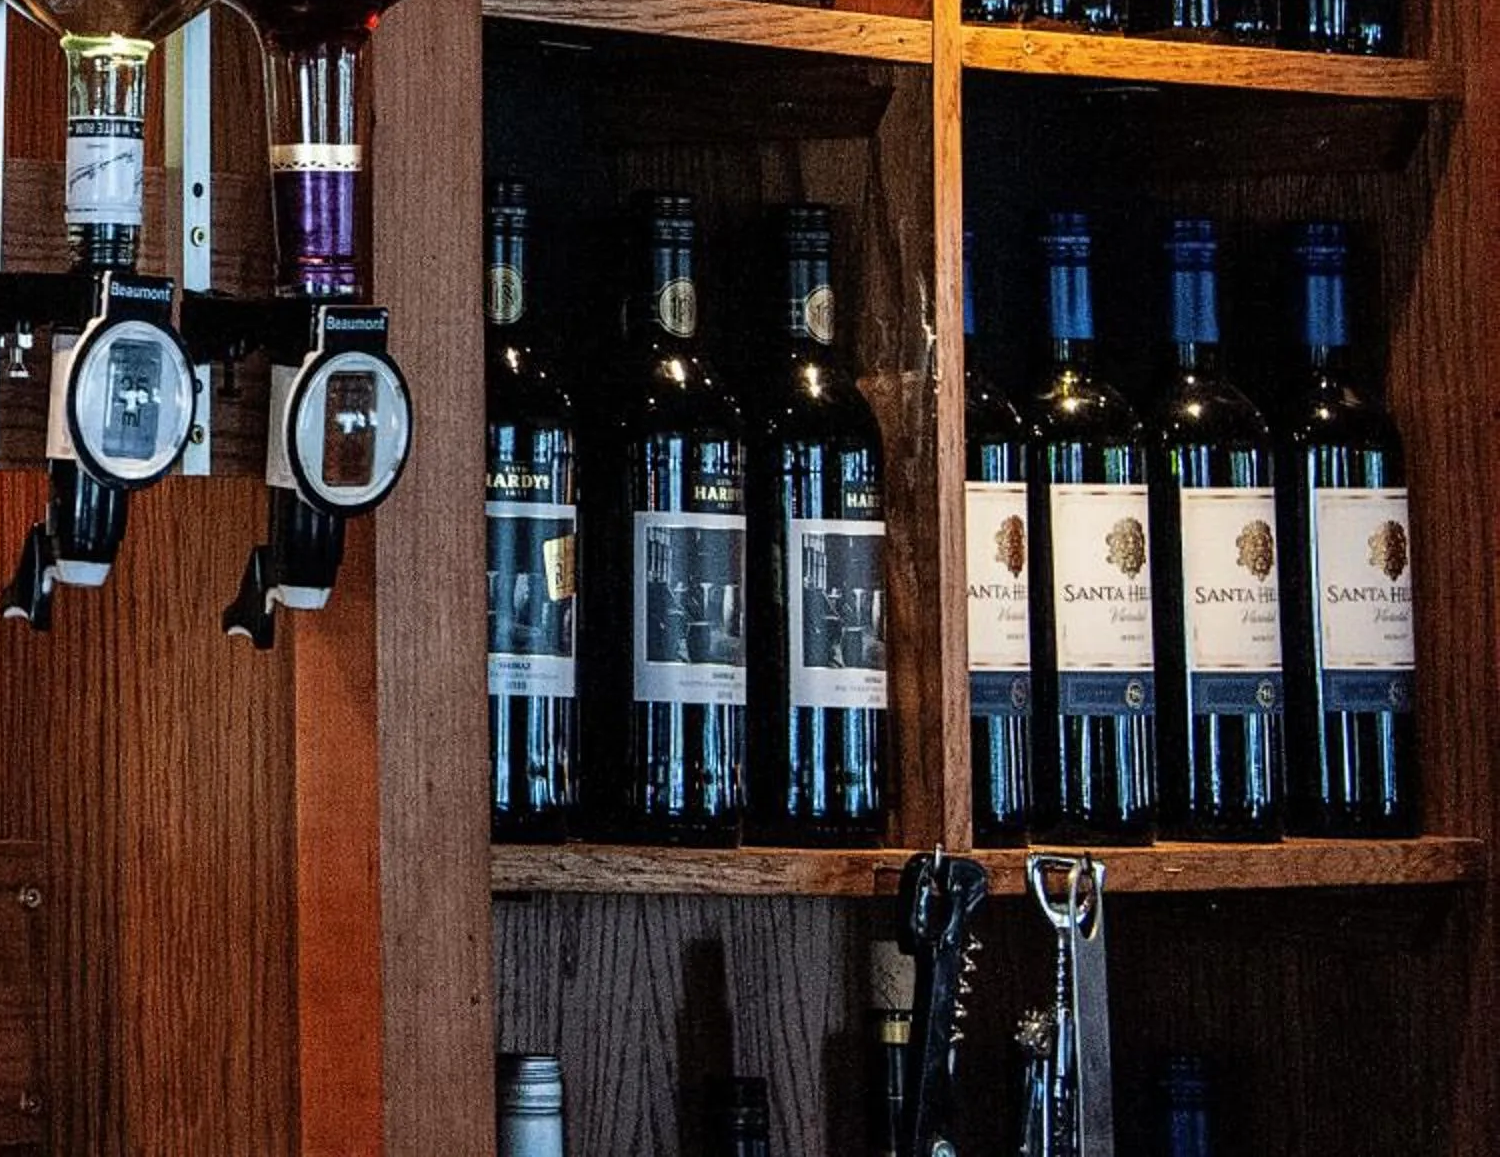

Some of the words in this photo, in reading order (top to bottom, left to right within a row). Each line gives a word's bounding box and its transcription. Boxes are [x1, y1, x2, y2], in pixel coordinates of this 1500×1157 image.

[111, 281, 171, 302] Beaumont
[326, 315, 385, 331] Beaumont
[1063, 583, 1125, 603] SANTA
[1195, 586, 1255, 604] SANTA
[1327, 584, 1388, 604] SANTA
